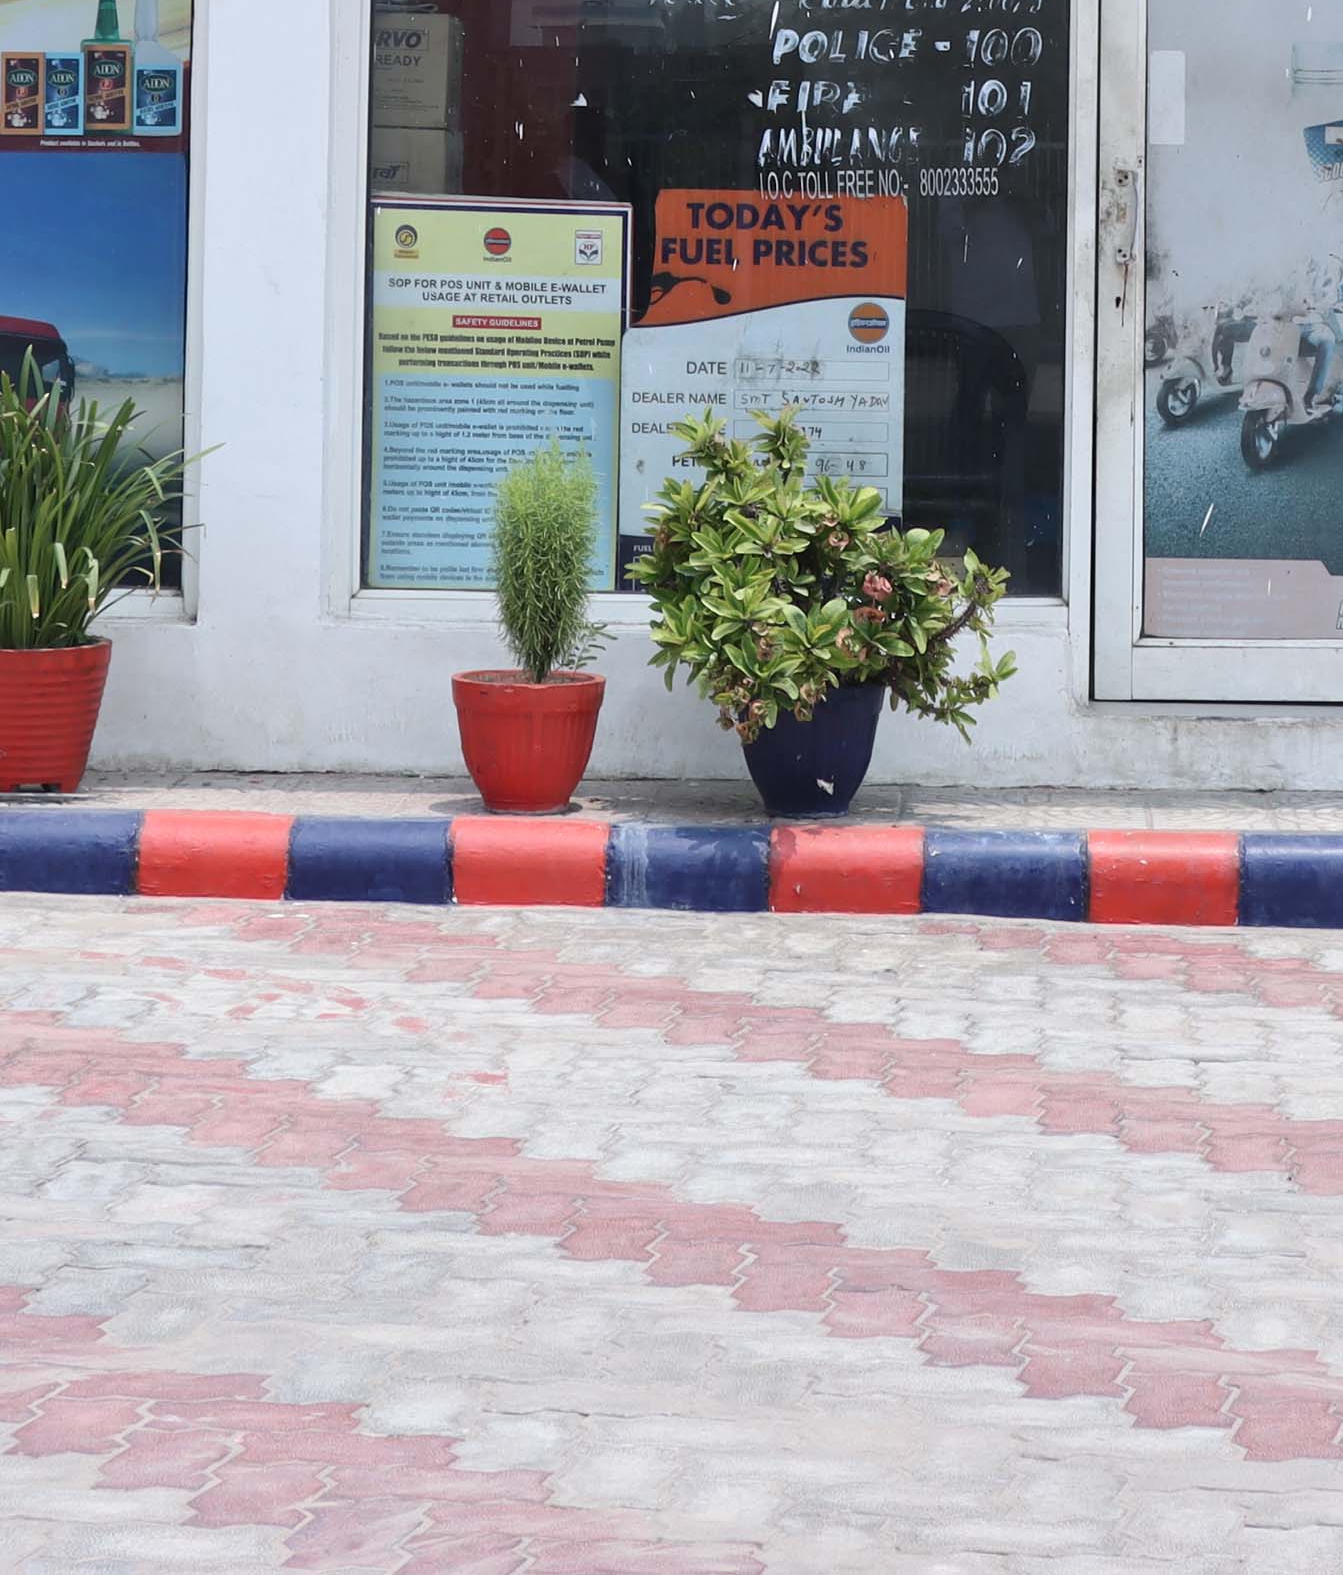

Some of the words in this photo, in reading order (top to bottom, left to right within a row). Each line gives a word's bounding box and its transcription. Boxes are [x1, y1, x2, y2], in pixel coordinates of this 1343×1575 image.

[772, 28, 923, 65] POLICE
[963, 27, 1043, 67] 100
[95, 64, 120, 74] ADON
[10, 73, 34, 83] ADON
[49, 73, 74, 83] ADON
[143, 78, 170, 89] ADON
[766, 80, 866, 114] FIRE
[961, 80, 1032, 118] 101
[760, 170, 793, 200] I.O.C
[798, 172, 833, 199] TOLL
[837, 170, 875, 198] FREE
[920, 168, 999, 197] 8002333555
[687, 203, 843, 232] TODAY'S
[661, 238, 739, 265] FUEL
[753, 239, 868, 268] PRICES
[388, 278, 411, 288] SOP
[415, 279, 437, 289] FOR
[441, 280, 463, 290] POS
[467, 280, 491, 290] UNIT
[495, 281, 502, 291] &
[506, 281, 547, 292] MOBILE
[551, 283, 606, 294] E-WALLET
[422, 291, 461, 302] USAGE
[464, 293, 479, 302] AT
[481, 294, 518, 304] RETAIL
[522, 295, 572, 305] OUTLETS
[456, 317, 486, 326] SAFETY
[489, 319, 539, 328] GUIDELINES
[846, 345, 890, 354] IndianOil
[687, 361, 727, 375] DATE
[632, 392, 686, 404] DEALER
[689, 393, 727, 404] NAME
